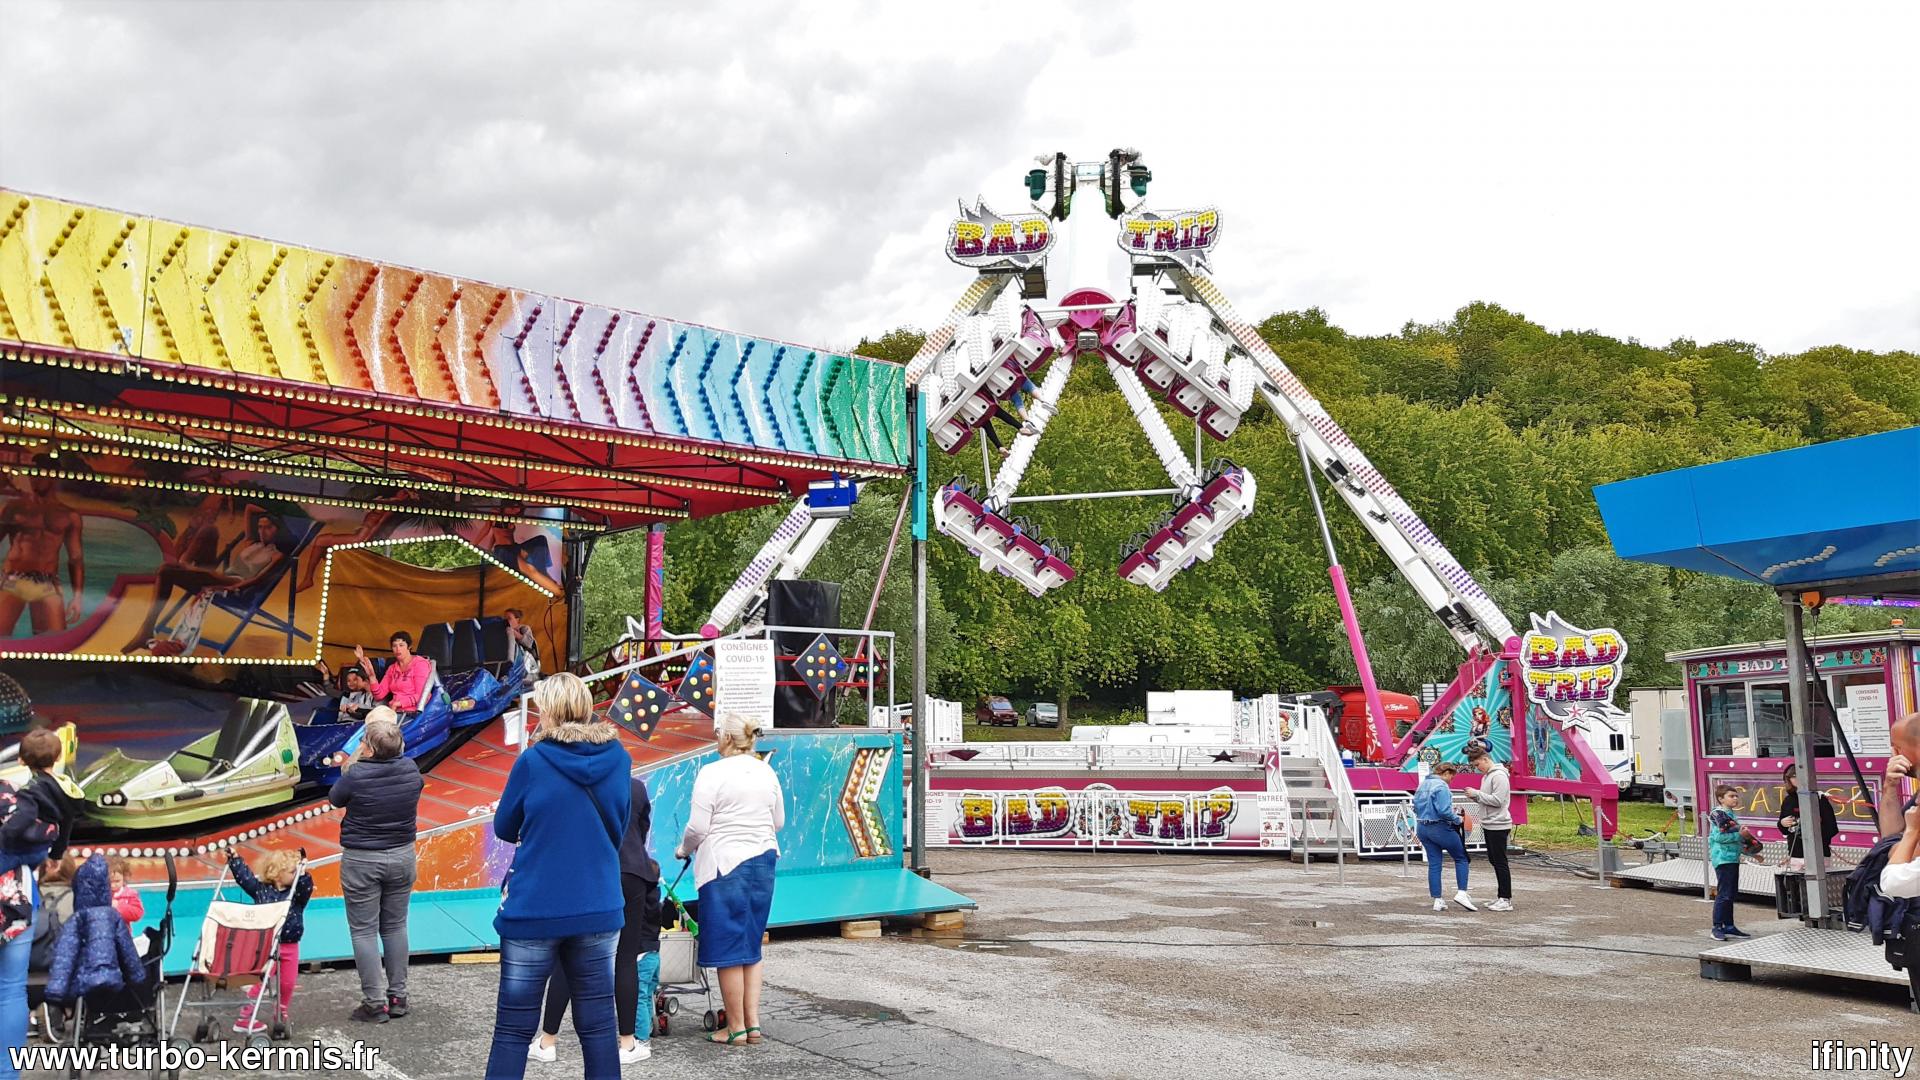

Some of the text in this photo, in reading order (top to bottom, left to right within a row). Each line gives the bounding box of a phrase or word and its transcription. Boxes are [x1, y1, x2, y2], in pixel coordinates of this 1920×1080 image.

[954, 209, 1219, 257] BAD TRIP
[721, 643, 769, 651] CONSIGNES
[725, 655, 765, 663] COVID-19
[1528, 632, 1621, 668] BAD
[1738, 654, 1826, 673] BAD TP
[1529, 664, 1615, 702] TRIP
[959, 792, 1071, 838] BAD
[1128, 792, 1234, 840] TRIP
[1734, 786, 1873, 818] CAISE
